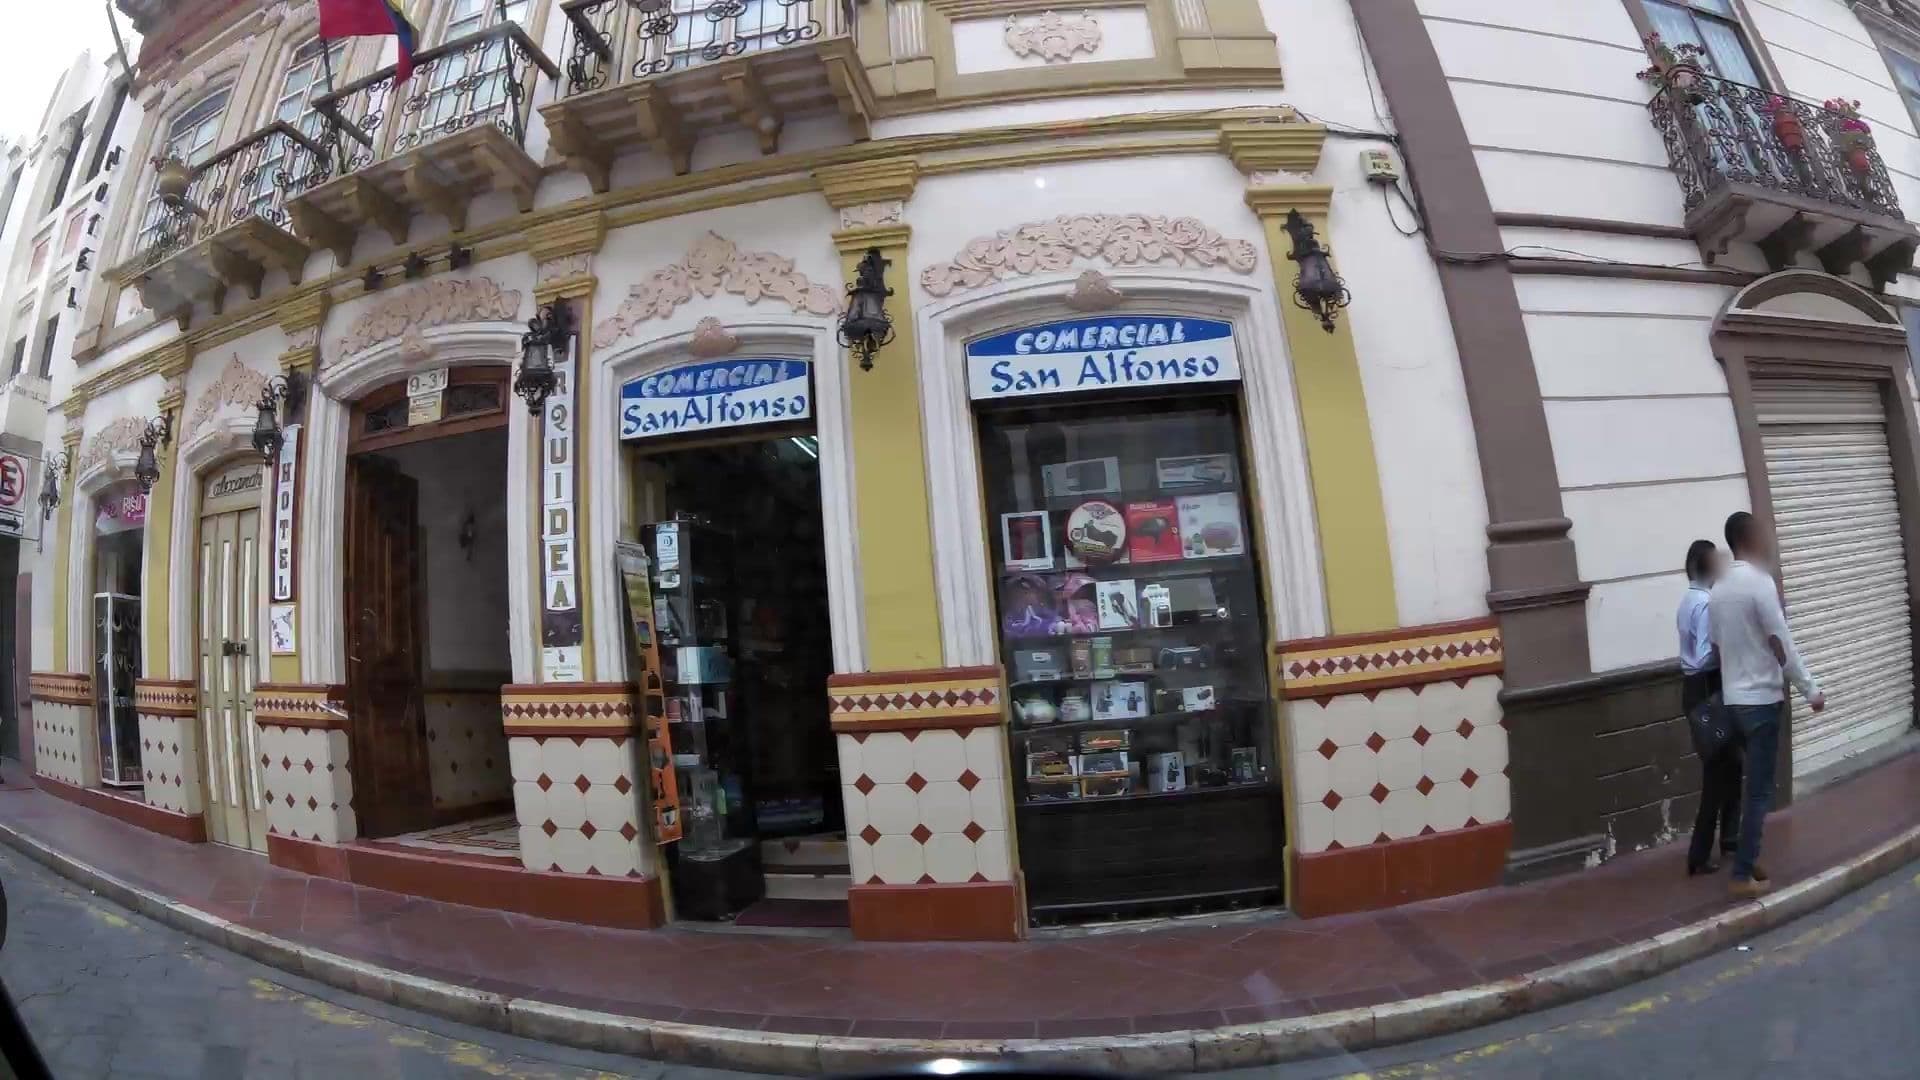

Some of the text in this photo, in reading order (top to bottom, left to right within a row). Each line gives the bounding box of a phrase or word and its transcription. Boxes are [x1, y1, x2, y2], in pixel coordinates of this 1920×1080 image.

[1015, 321, 1186, 355] COMERCIAL
[641, 361, 789, 398] COMERCIAL
[990, 350, 1219, 392] San Alfonso
[278, 462, 293, 598] HOTEL
